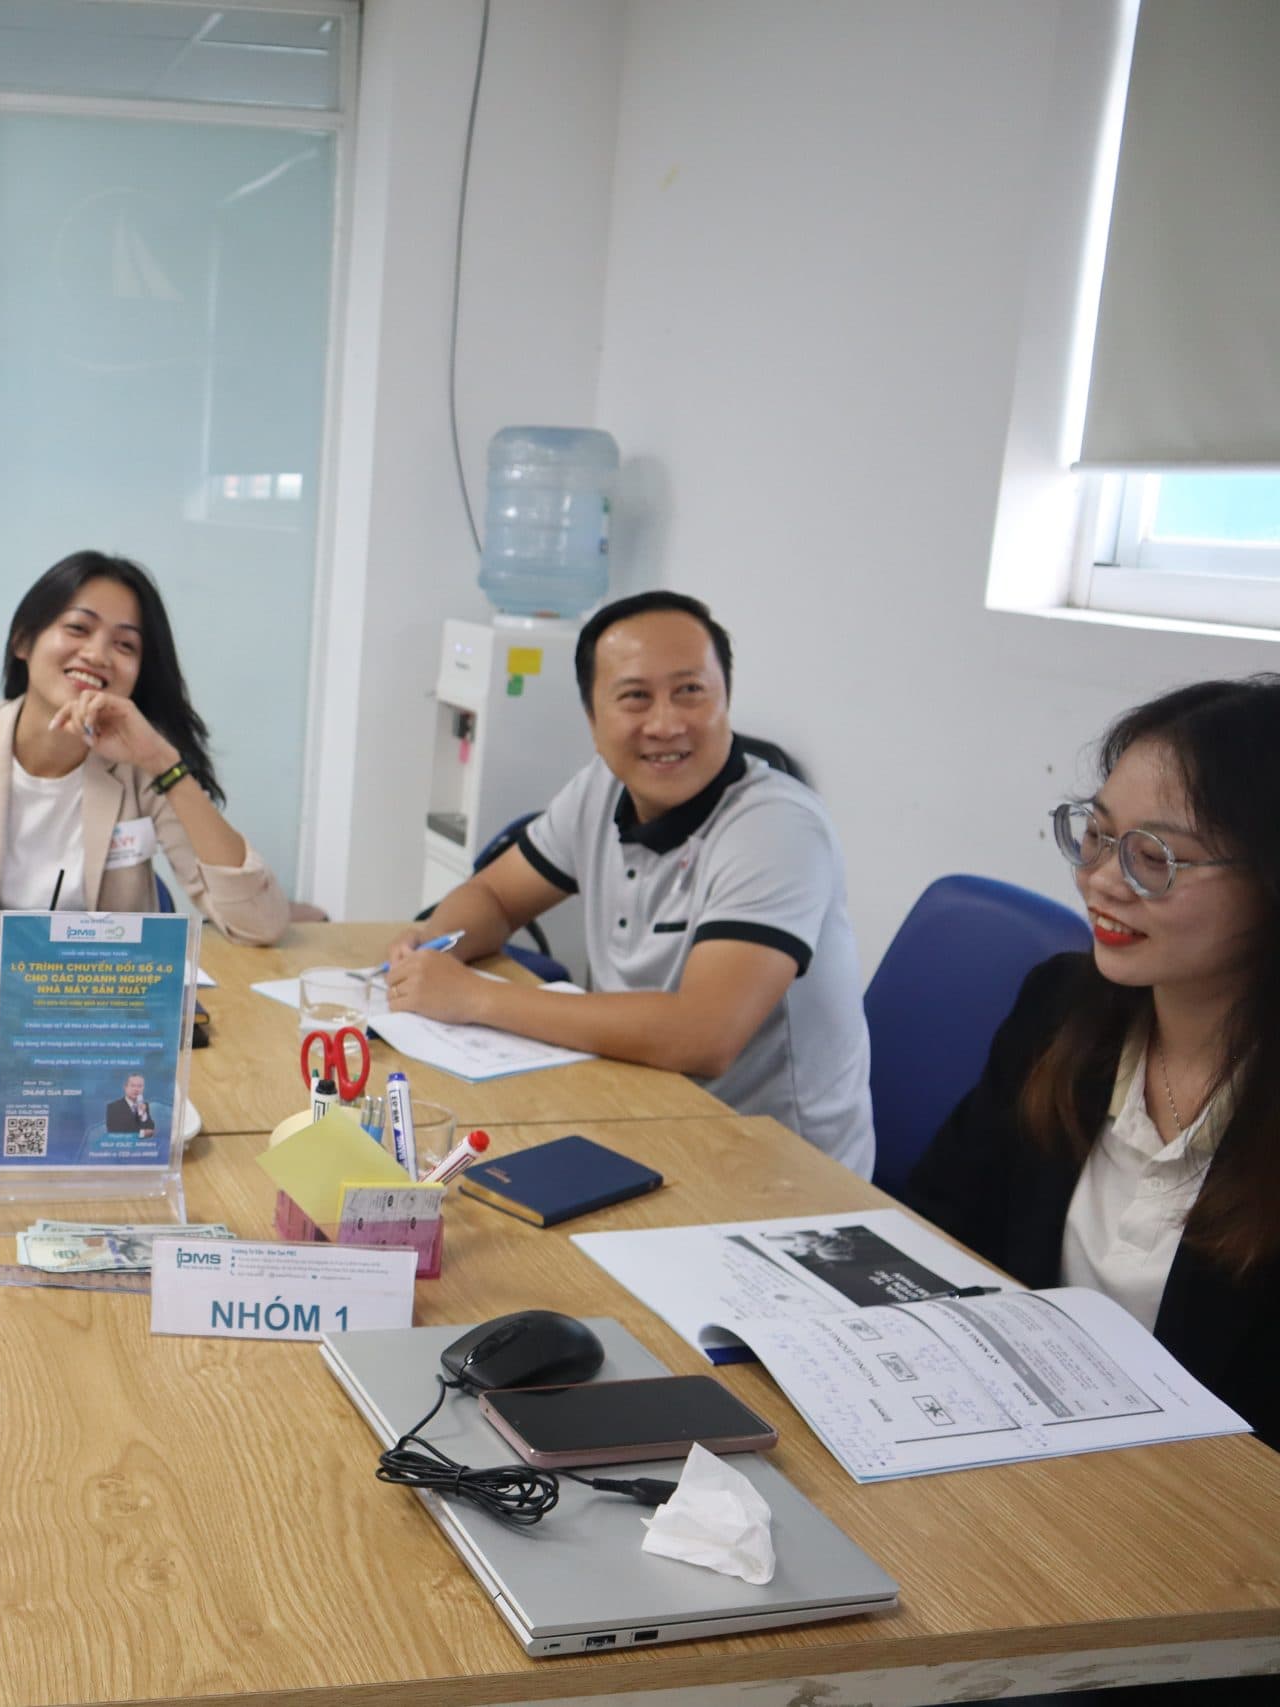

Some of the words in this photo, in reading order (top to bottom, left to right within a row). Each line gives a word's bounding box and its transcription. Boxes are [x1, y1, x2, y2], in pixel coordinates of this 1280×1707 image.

[11, 961, 25, 973] LỘ
[29, 961, 63, 972] TRÌNH
[66, 961, 112, 972] CHUYỂN
[116, 961, 135, 972] ĐỔI
[138, 960, 154, 972] SỐ
[156, 964, 173, 974] 4.0
[24, 973, 48, 983] CHO
[51, 972, 73, 983] CÁC
[77, 974, 116, 984] DOANH
[119, 974, 162, 986] NGHIỆP
[37, 984, 61, 994] NHÀ
[63, 983, 88, 994] MÁY
[117, 983, 148, 994] XUẤT
[211, 1296, 320, 1332] NHÓM
[335, 1306, 348, 1332] 1
